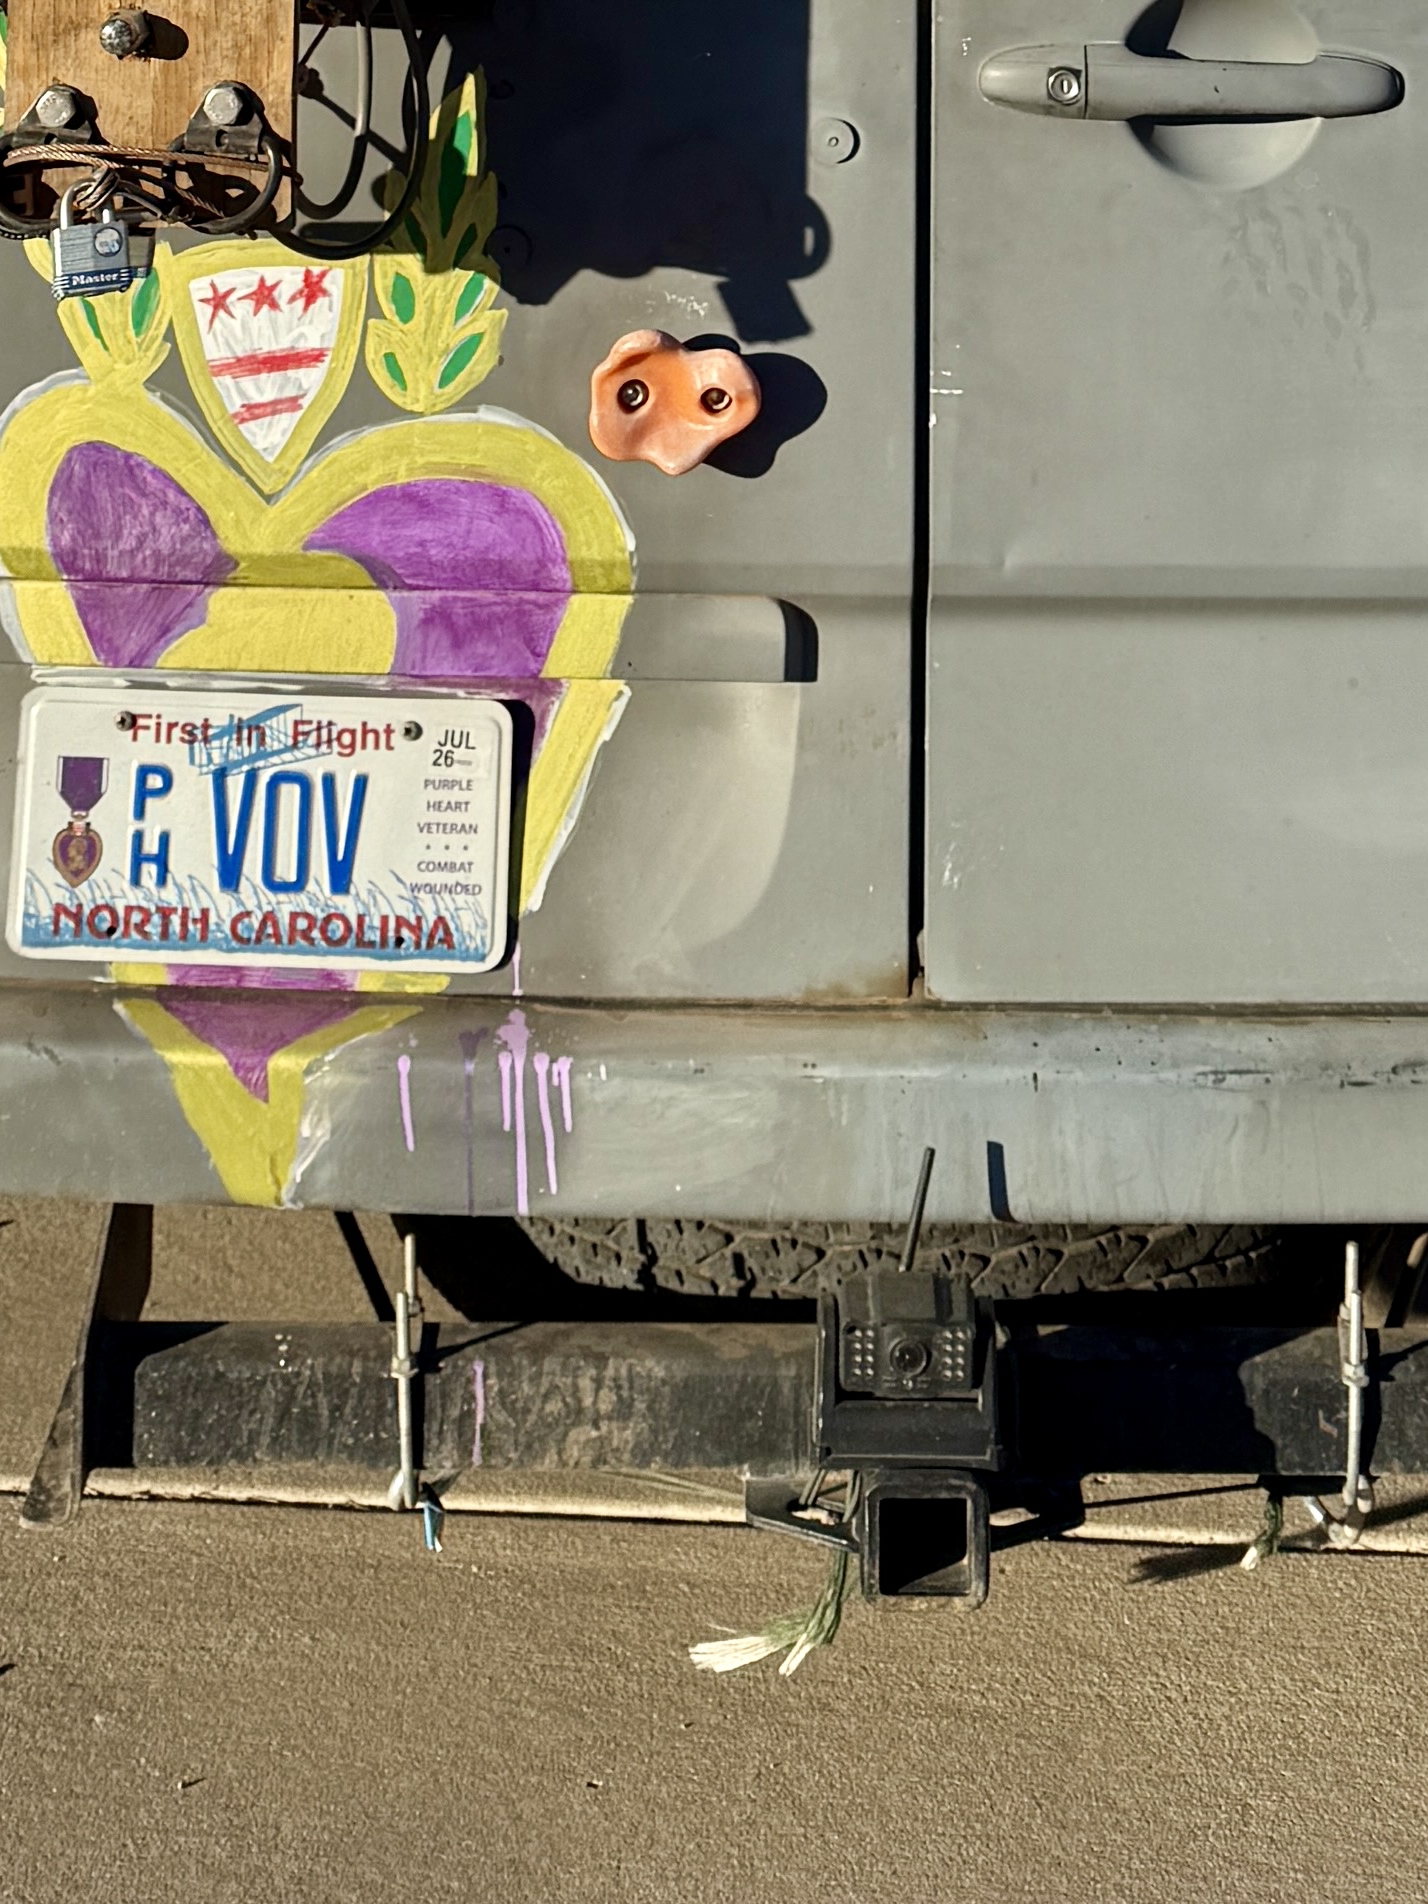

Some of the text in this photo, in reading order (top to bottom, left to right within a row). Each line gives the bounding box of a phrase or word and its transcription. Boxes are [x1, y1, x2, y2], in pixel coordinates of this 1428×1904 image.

[72, 273, 119, 285] Master
[129, 713, 214, 746] First
[291, 719, 396, 758] Flight
[437, 729, 477, 750] JUL
[432, 749, 455, 768] 26
[423, 779, 474, 792] PURPLE
[426, 801, 471, 813] HEART
[417, 823, 479, 835] VETERAN
[417, 861, 474, 874] COMBAT
[410, 883, 482, 897] WOUNDED
[52, 903, 456, 951] NORTH CAROLINA
